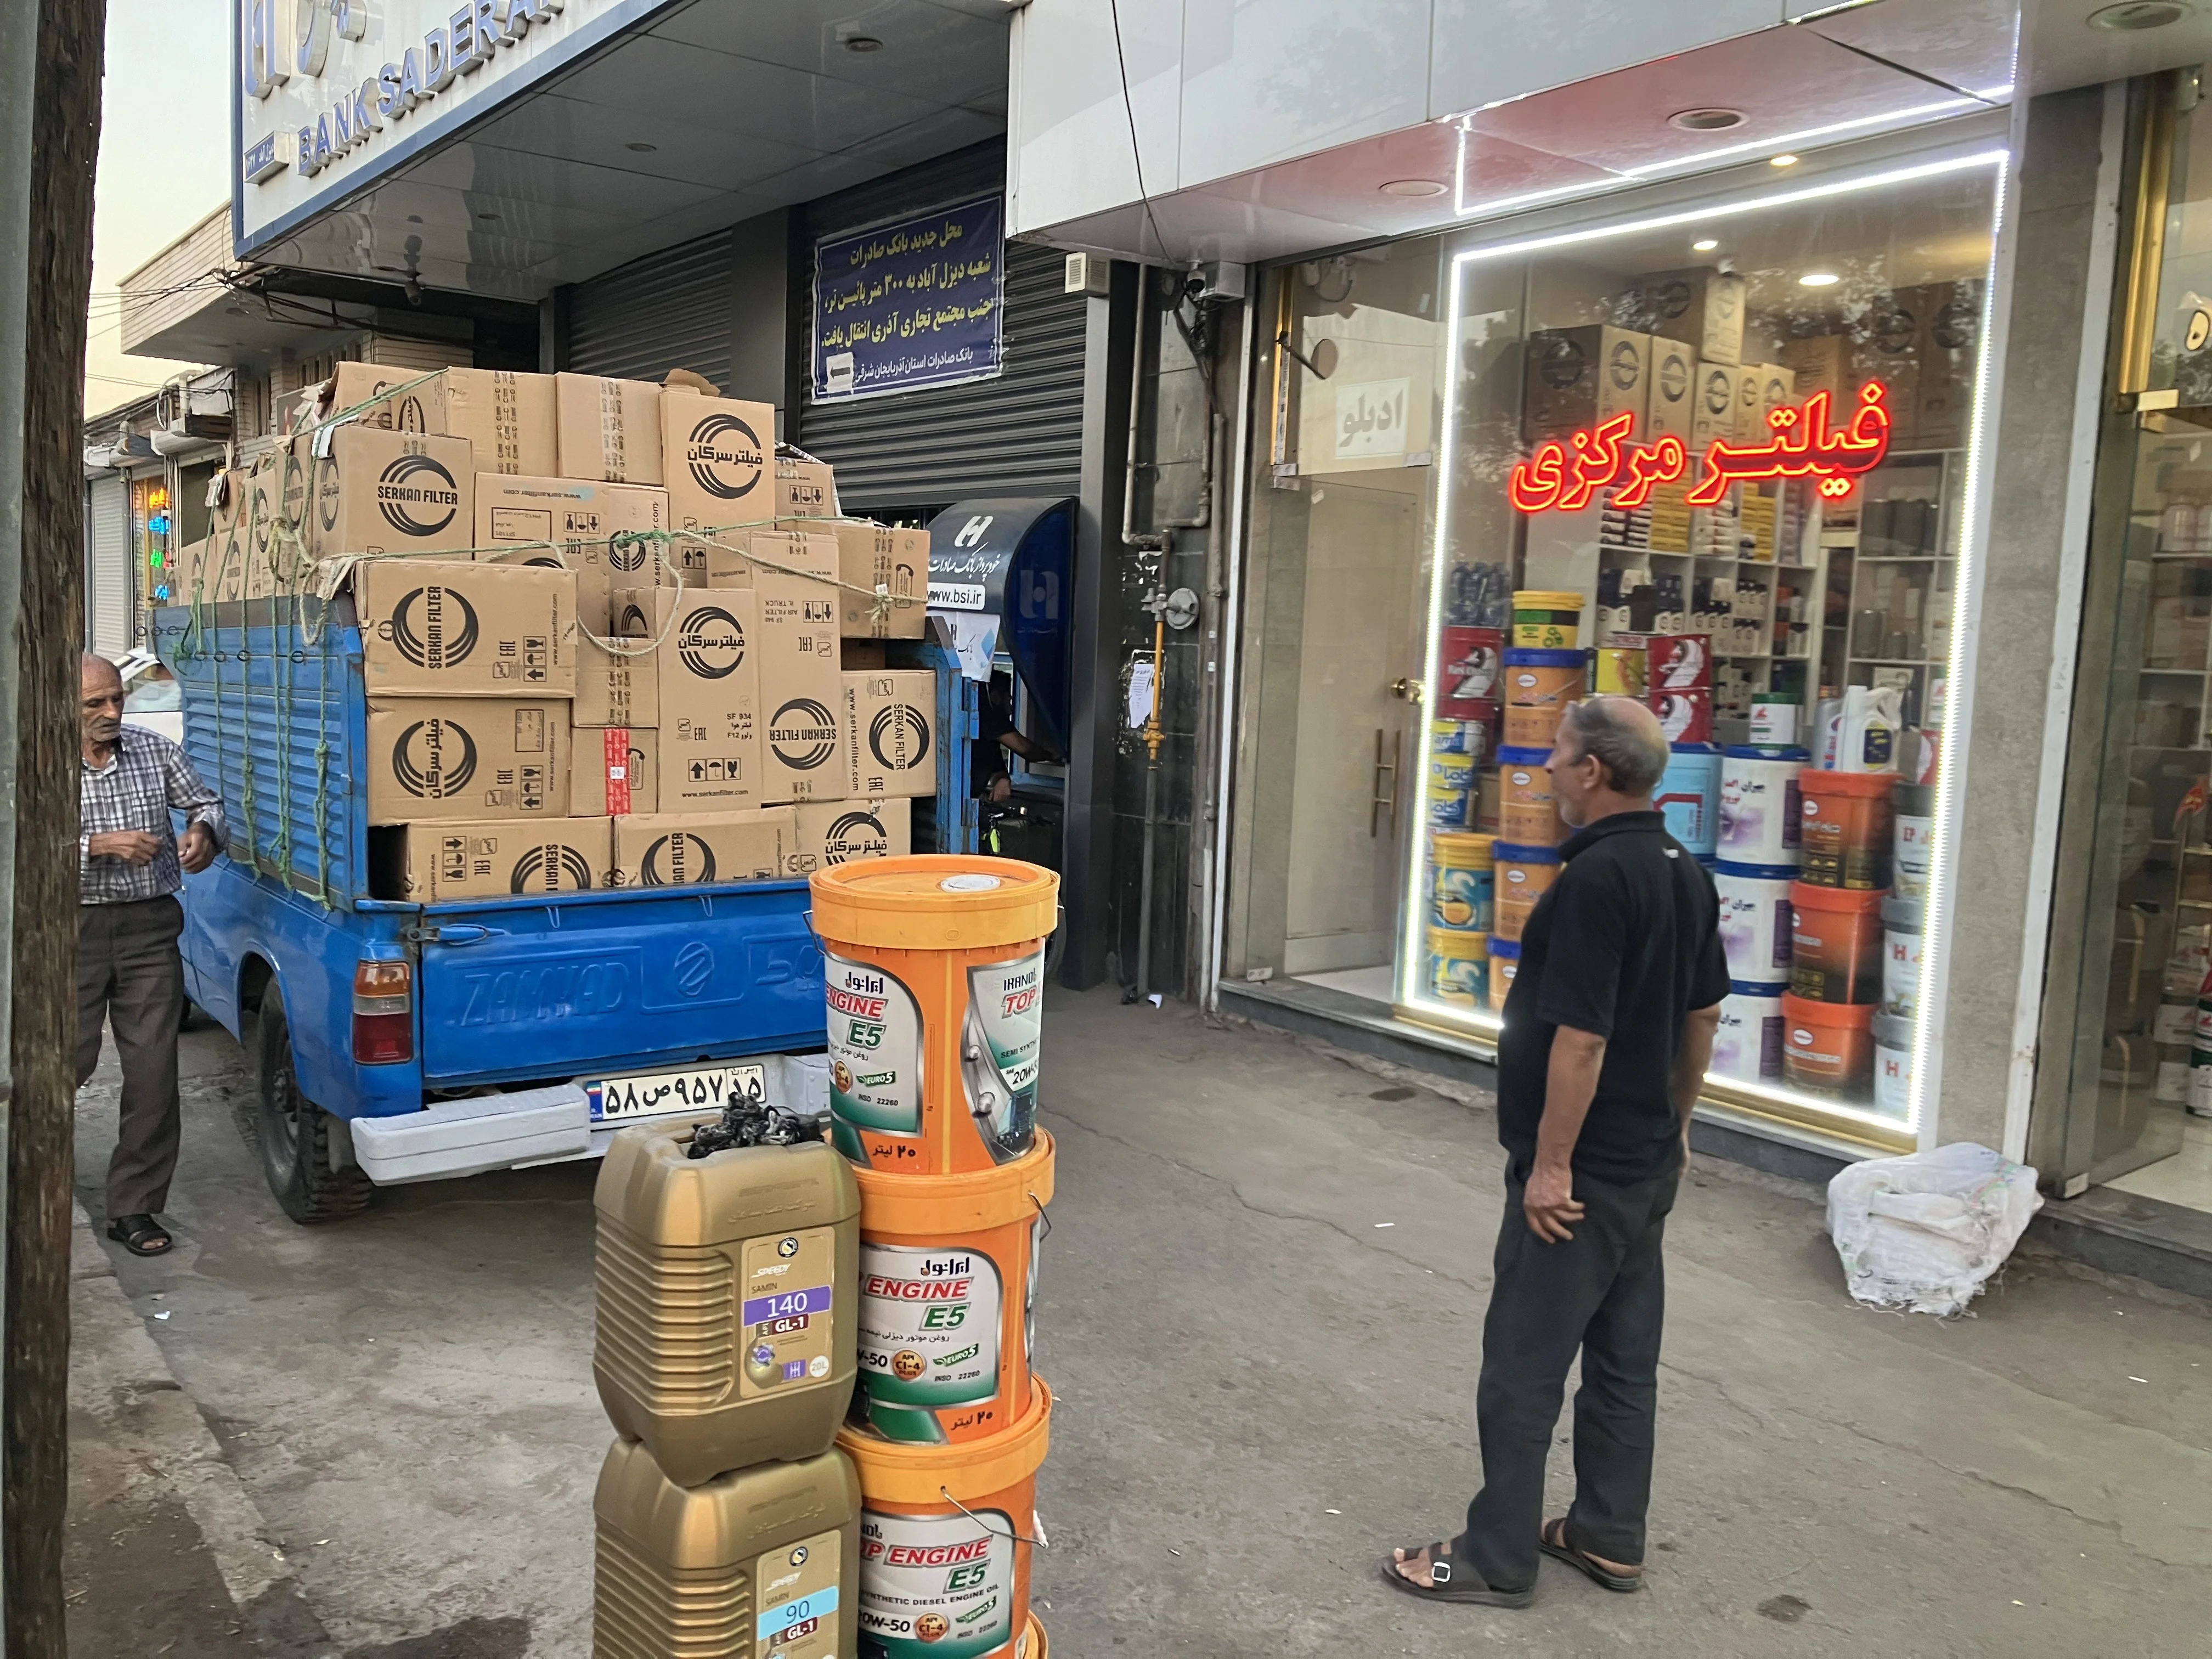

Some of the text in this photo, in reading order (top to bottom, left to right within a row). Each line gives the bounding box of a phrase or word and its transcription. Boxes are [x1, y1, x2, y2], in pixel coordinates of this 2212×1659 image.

[297, 77, 380, 177] BANK
[377, 0, 565, 117] SADERA
[850, 221, 963, 267] محل جدید بانک صادرات
[917, 263, 936, 286] آباد
[939, 261, 964, 289] دیزل
[967, 252, 991, 278] شعبه
[868, 284, 882, 305] متر
[884, 274, 903, 296] ۳۰۰
[906, 276, 917, 294] به
[933, 306, 965, 331] مجتمع
[968, 297, 992, 320] جنب
[845, 319, 870, 348] انتقال
[872, 311, 898, 343] آذری
[900, 308, 932, 338] تجاری
[854, 348, 973, 382] بانک صادرات استان آذربایجان شرقی
[1338, 387, 1404, 448] ادبلو
[687, 445, 763, 467] فیلتر سرکان
[1511, 381, 1892, 511] فیلتر مرکزی
[377, 485, 458, 505] SERKAN FILTER
[955, 542, 989, 579] بانک
[927, 588, 981, 605] ww.bsi.ir
[428, 585, 442, 669] SERKAN FILTER
[678, 634, 745, 651] فیلتر سرکان
[769, 729, 837, 741] SERKAN FILTER
[848, 688, 859, 791] www.serkanfilter.com
[893, 703, 906, 770] SERKAN FILTER
[426, 718, 443, 799] فیلتر سرکان
[681, 789, 748, 798] www.serkanfilter.com
[672, 833, 684, 865] FILTER
[825, 839, 888, 854] فیلتر سرکان
[545, 844, 558, 882] SERKAN
[845, 972, 884, 994] ایرانول
[1006, 988, 1037, 1013] TOP
[849, 1022, 884, 1047] E5
[1001, 1047, 1018, 1059] SEMI
[877, 1097, 899, 1106] 22260
[873, 1144, 893, 1158] لیتر
[920, 1257, 970, 1276] ایرانول
[867, 1277, 972, 1299] ENGINE
[767, 1293, 808, 1318] 140
[924, 1304, 968, 1329] E5
[774, 1316, 805, 1333] GL-1
[882, 1331, 904, 1340] دیزلی
[929, 1335, 950, 1343] روغن
[958, 1370, 980, 1380] 22260
[951, 1415, 973, 1431] لیتر
[889, 1538, 991, 1565] ENGINE
[948, 1562, 988, 1590] E5
[950, 1589, 984, 1603] ENGINE
[986, 1584, 1000, 1593] OIL
[786, 1600, 810, 1624] 90
[787, 1620, 814, 1640] GL-1
